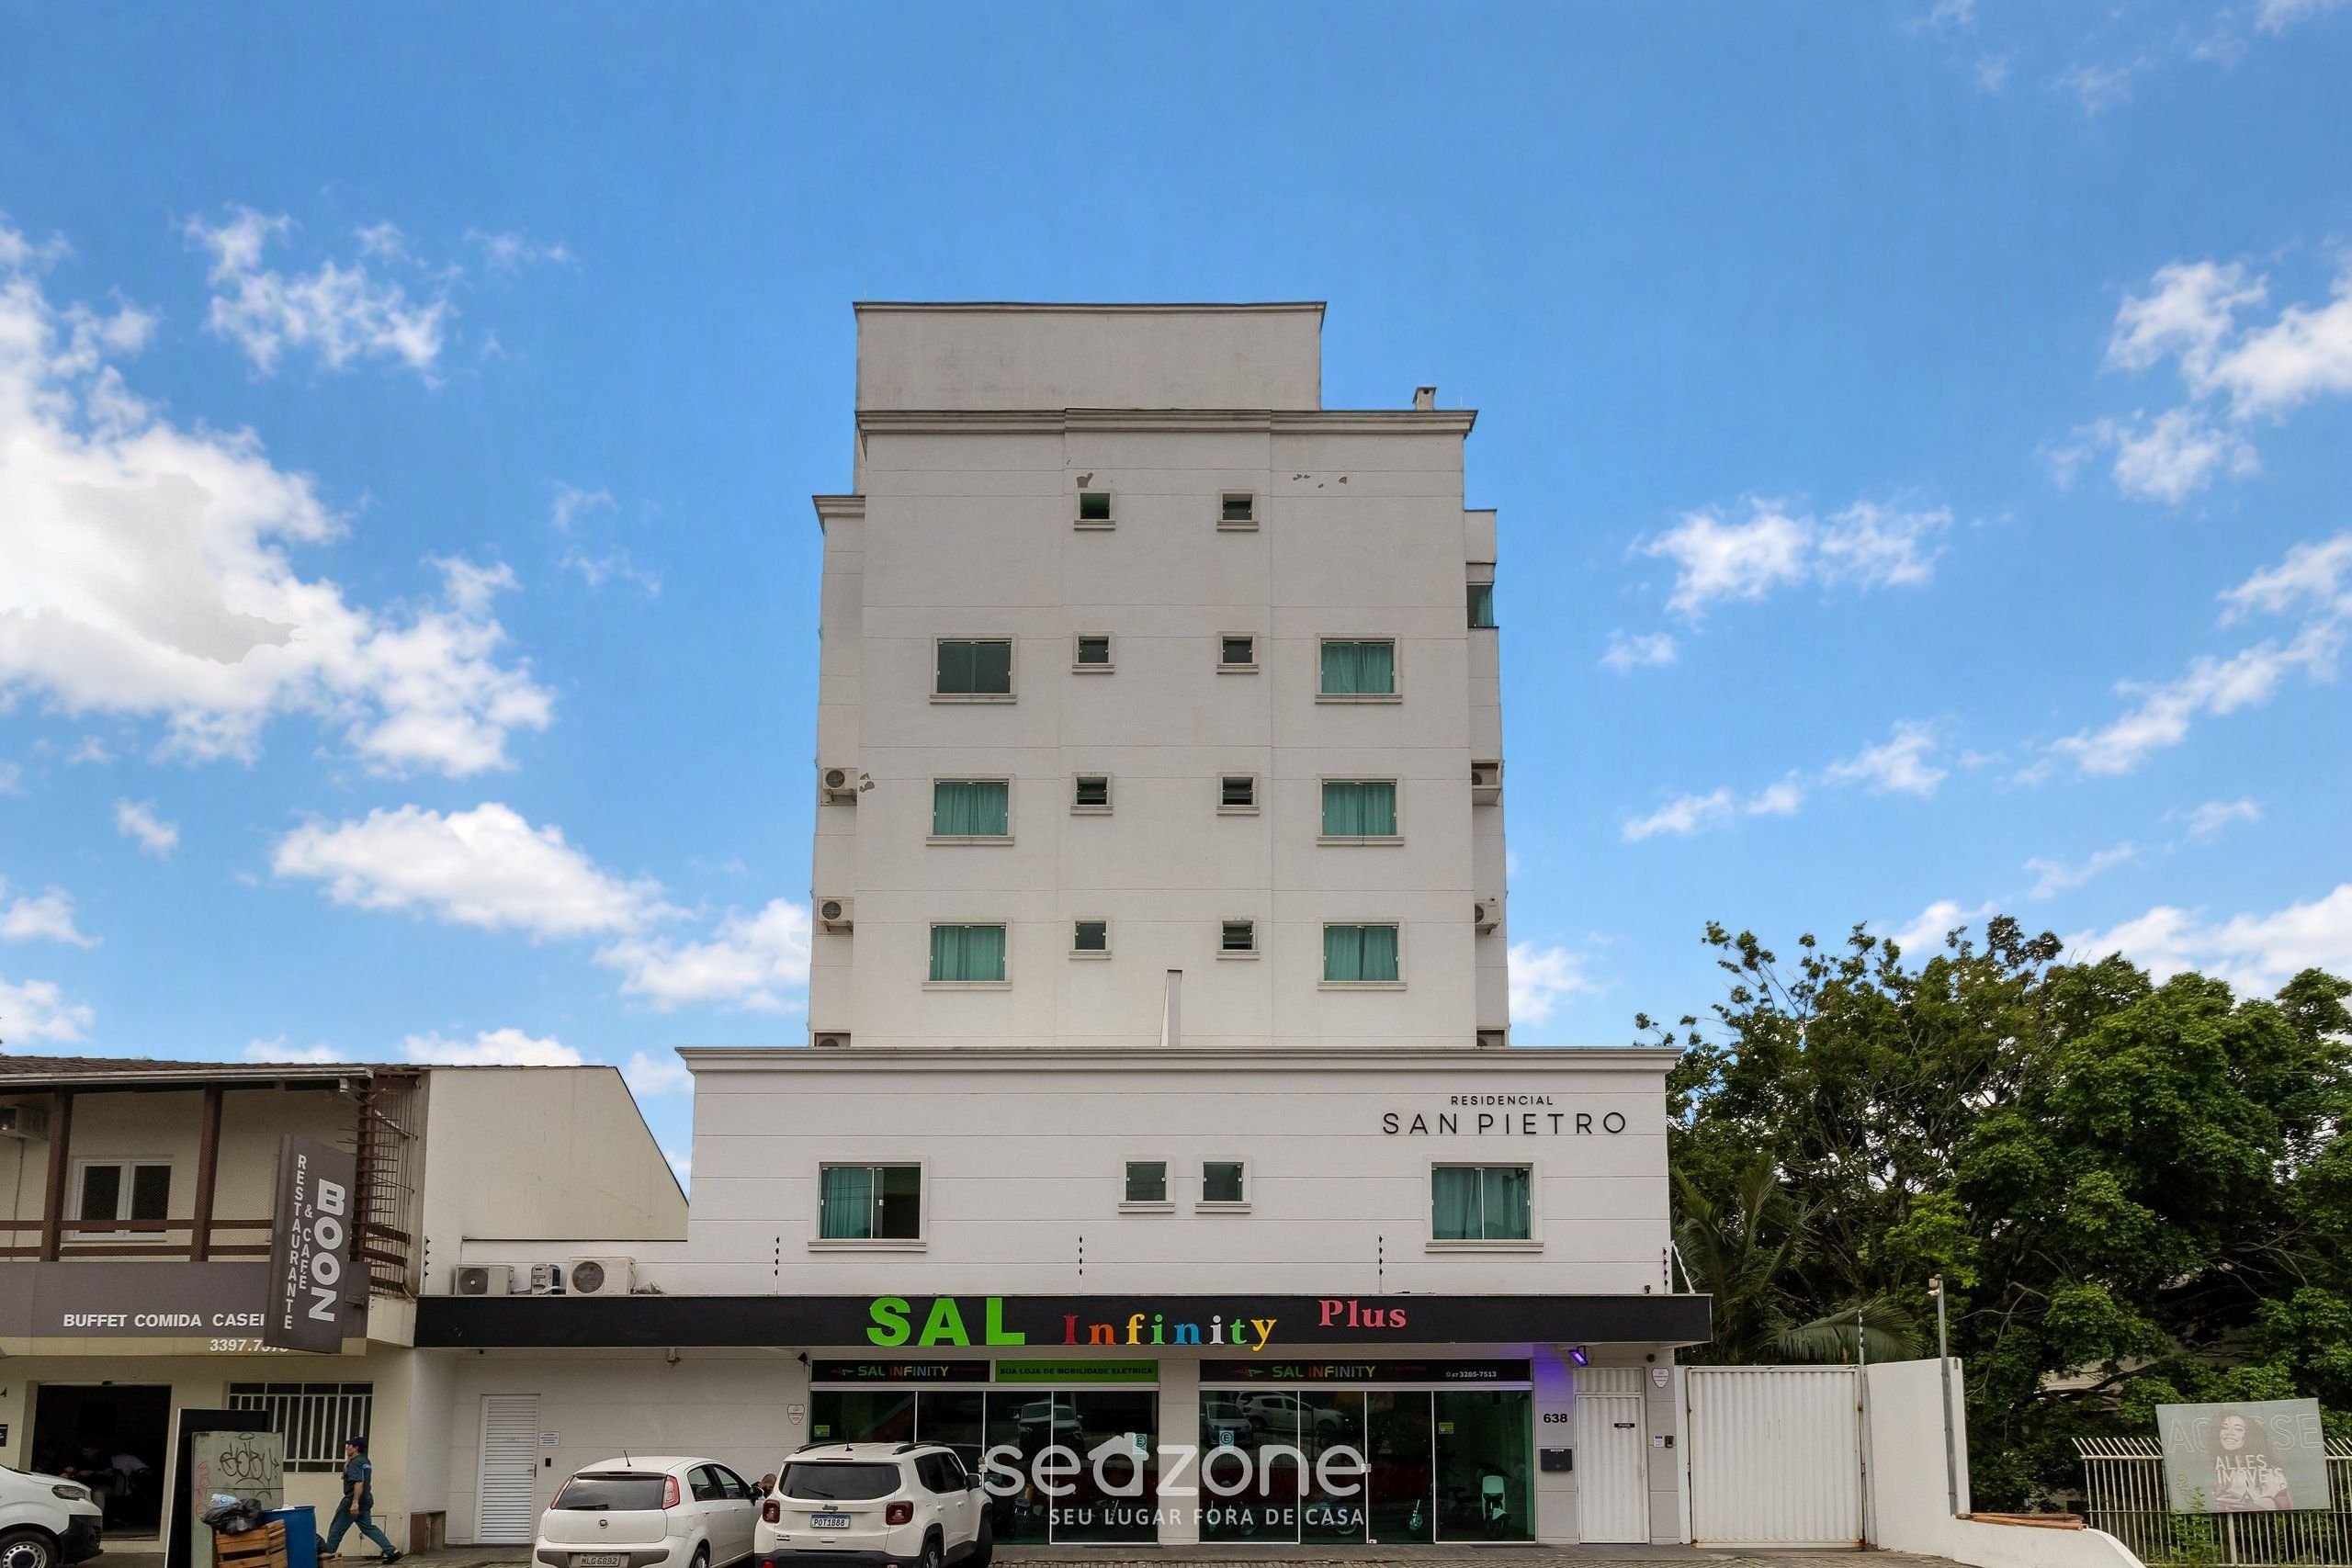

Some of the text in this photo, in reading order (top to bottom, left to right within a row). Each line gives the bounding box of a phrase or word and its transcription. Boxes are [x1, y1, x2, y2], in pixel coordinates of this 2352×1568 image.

[1451, 1096, 1554, 1105] RESIDENCIAL
[1383, 1111, 1626, 1134] SAN PIETRO
[284, 1154, 307, 1330] RESTAURANTE
[309, 1179, 345, 1322] BOOZ
[299, 1228, 311, 1290] CAFÉ
[63, 1313, 265, 1327] BUFFET COMIDA CASEI
[866, 1297, 1407, 1352] SAL Infinity Plus
[858, 1366, 886, 1376] SAL
[888, 1366, 949, 1376] INFINITY
[1272, 1366, 1303, 1377] SAL
[1308, 1366, 1375, 1377] INFINITY
[1544, 1414, 1567, 1423] 638
[2167, 1414, 2324, 1453] ACSE
[2216, 1454, 2267, 1470] ALLES
